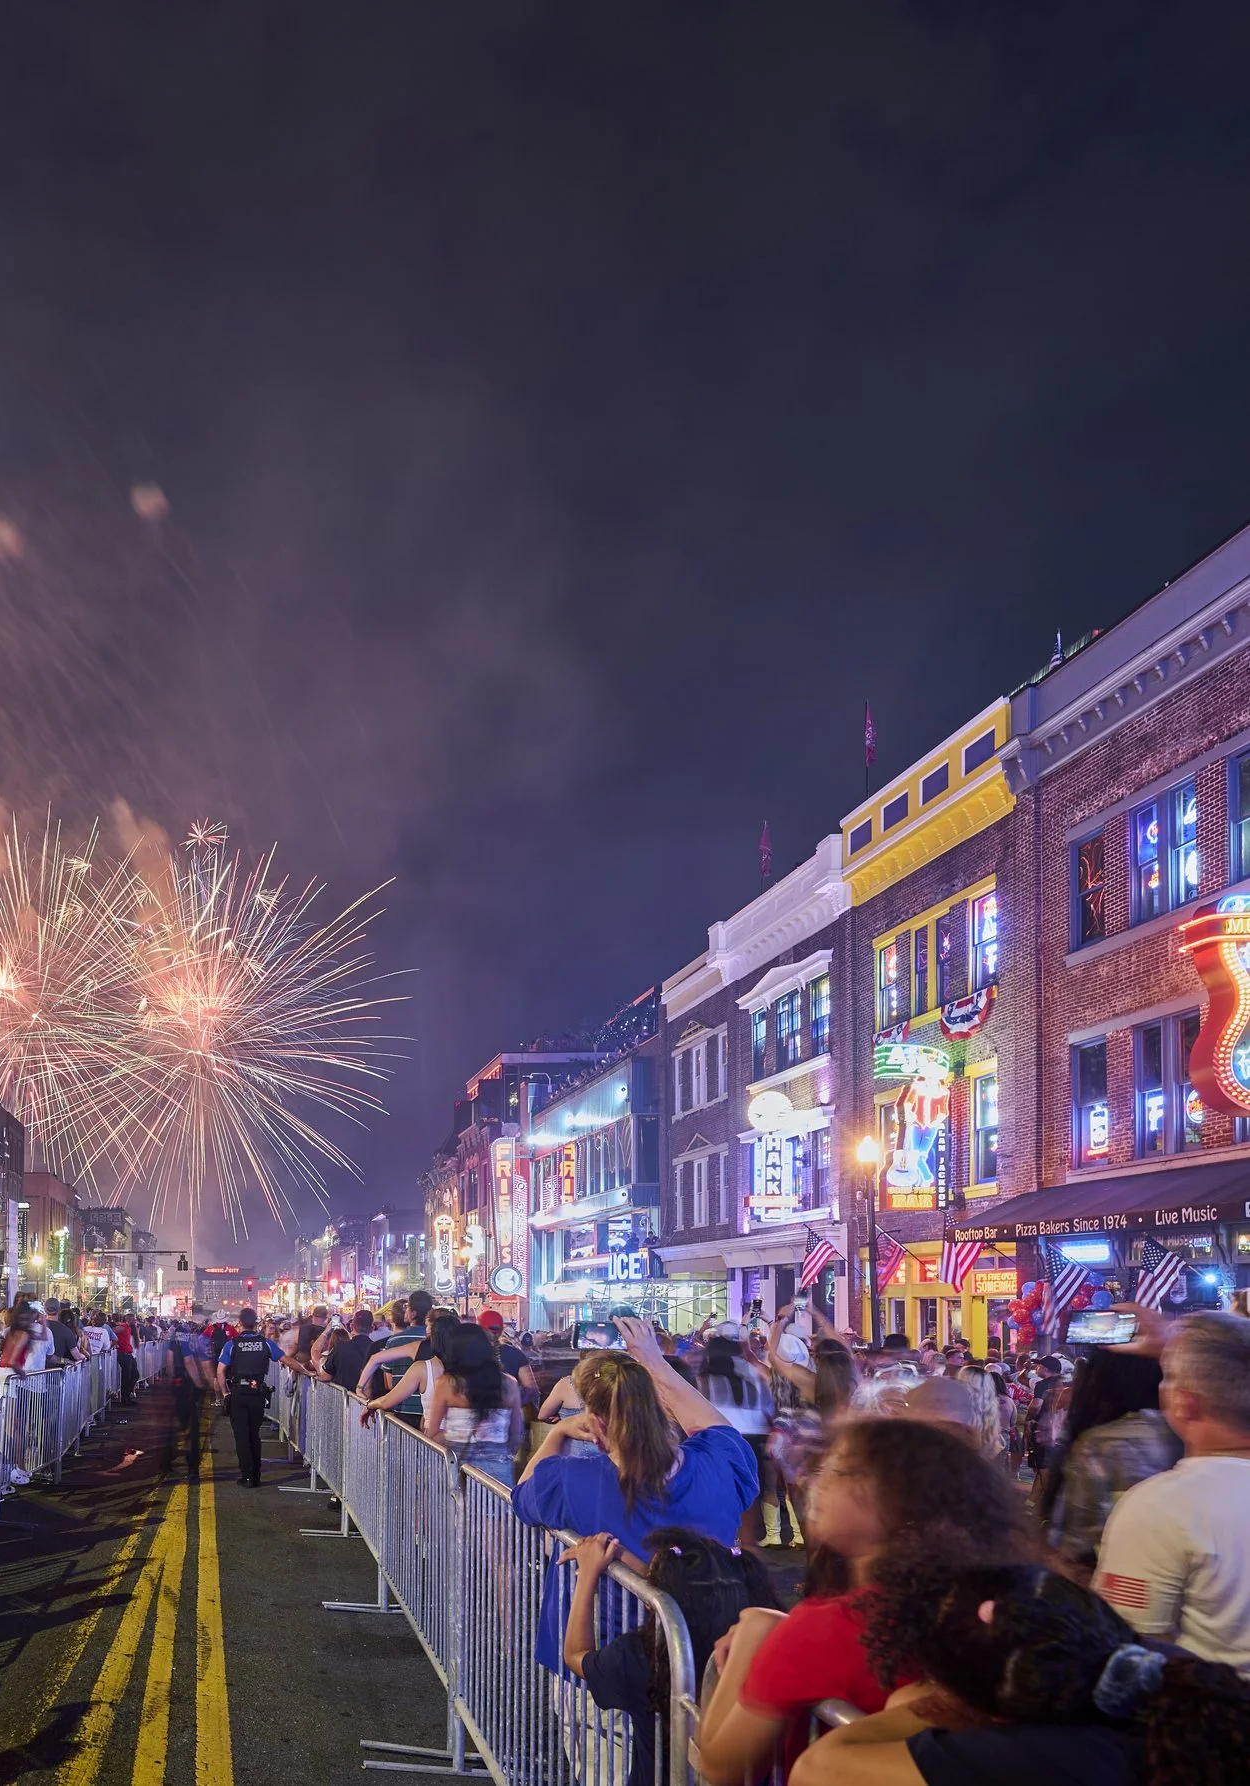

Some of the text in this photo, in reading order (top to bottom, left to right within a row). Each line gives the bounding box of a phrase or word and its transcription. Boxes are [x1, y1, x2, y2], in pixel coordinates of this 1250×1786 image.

[938, 1157, 946, 1208] JACKSON
[892, 1194, 934, 1208] BAR
[1015, 1214, 1128, 1238] Pizza Bakers Since 1974
[1155, 1205, 1218, 1226] Live Music
[955, 1227, 998, 1242] Rooftop Bar
